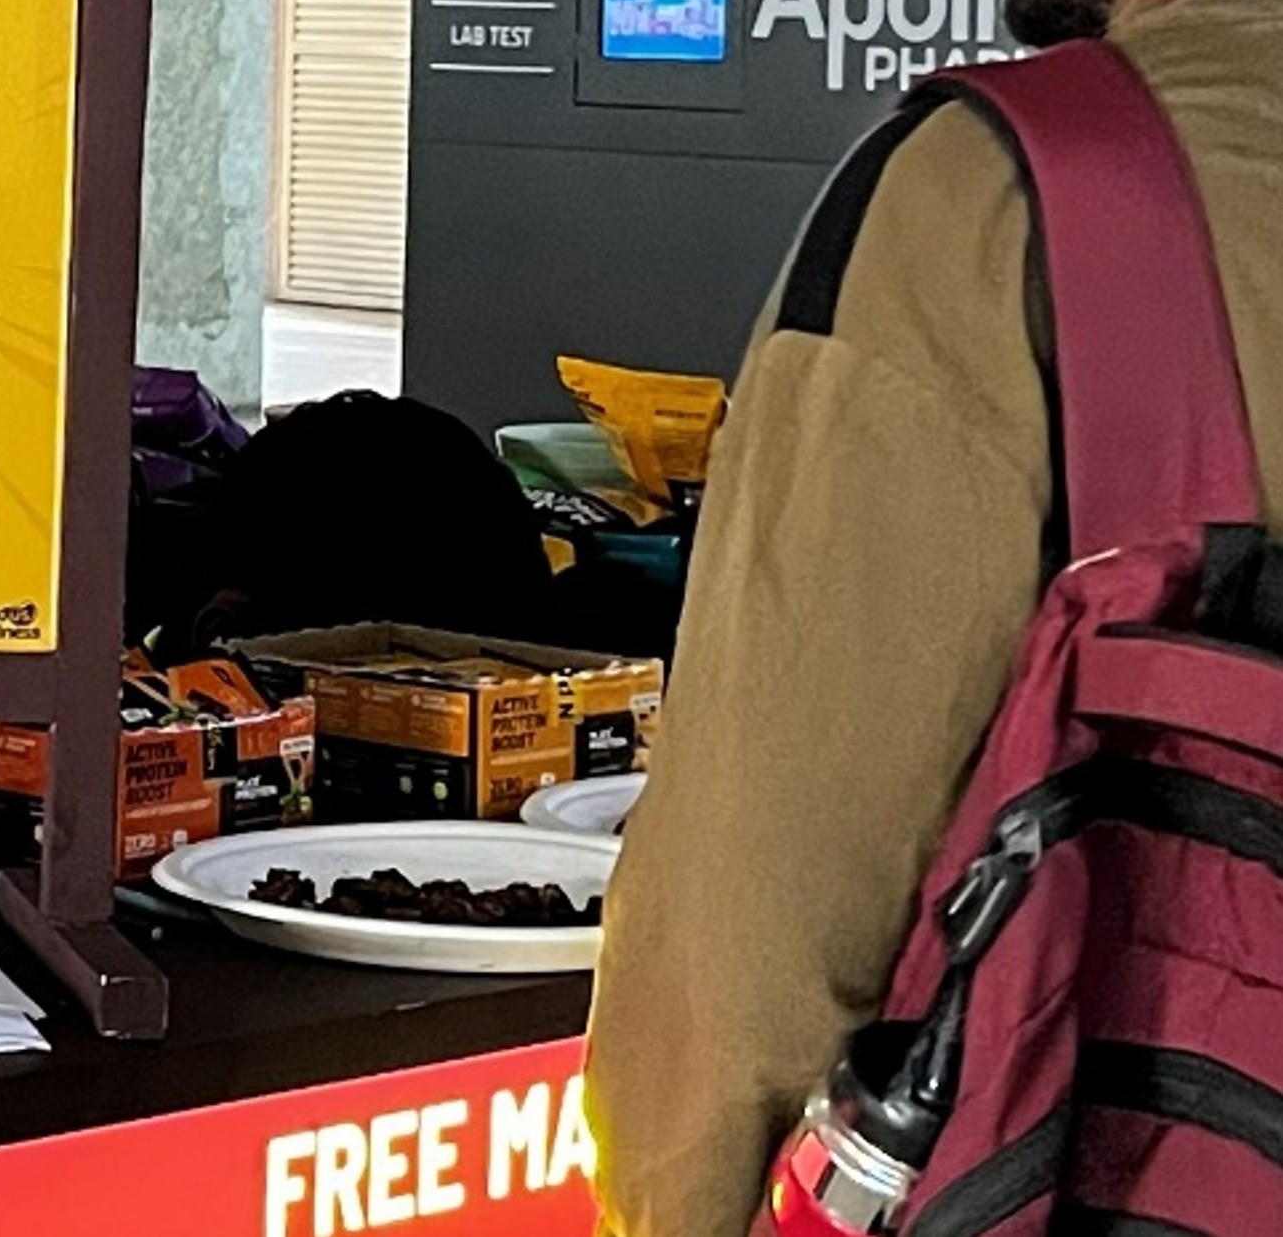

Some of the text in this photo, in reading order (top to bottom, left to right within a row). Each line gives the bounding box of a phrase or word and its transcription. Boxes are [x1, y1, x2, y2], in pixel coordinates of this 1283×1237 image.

[450, 25, 533, 48] LAB TEST
[265, 1074, 598, 1237] FREE MA
